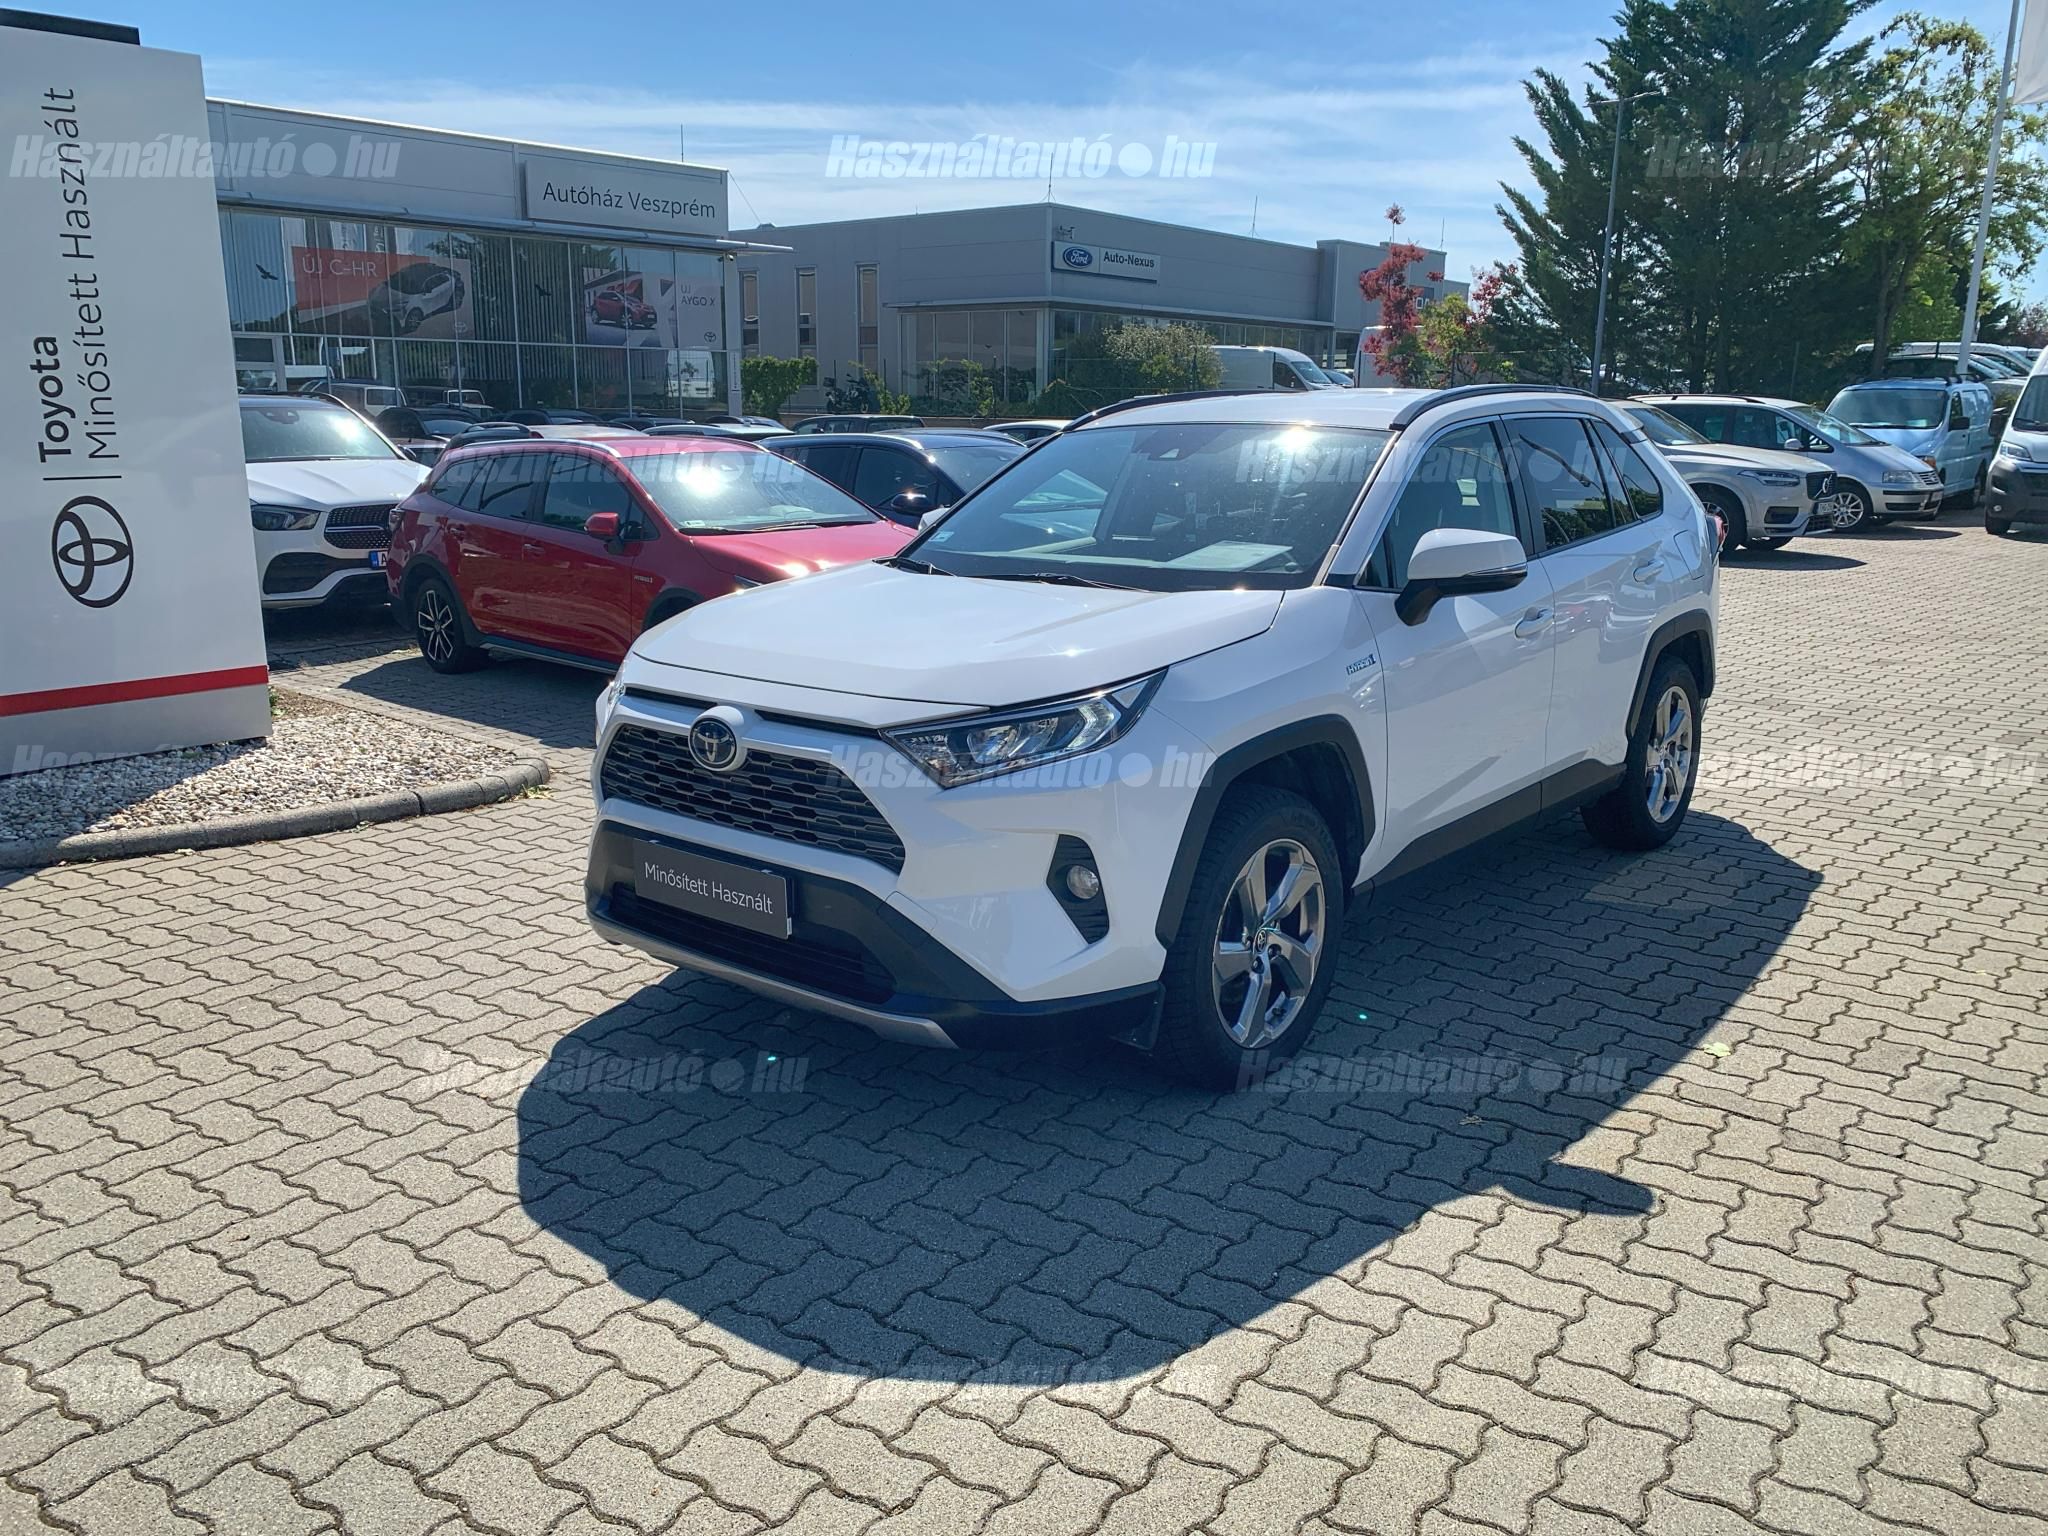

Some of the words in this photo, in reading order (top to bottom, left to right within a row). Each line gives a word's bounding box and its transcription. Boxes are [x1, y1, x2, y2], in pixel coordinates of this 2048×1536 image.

[41, 87, 95, 259] Használt
[543, 182, 623, 208] Autóház
[628, 192, 715, 218] Veszprém
[329, 259, 378, 277] C-HR
[1103, 251, 1155, 268] Auto-Nexus
[68, 272, 120, 459] Minősített
[30, 336, 75, 462] Toyota
[644, 861, 708, 897] Minősített
[712, 881, 774, 914] Használt
